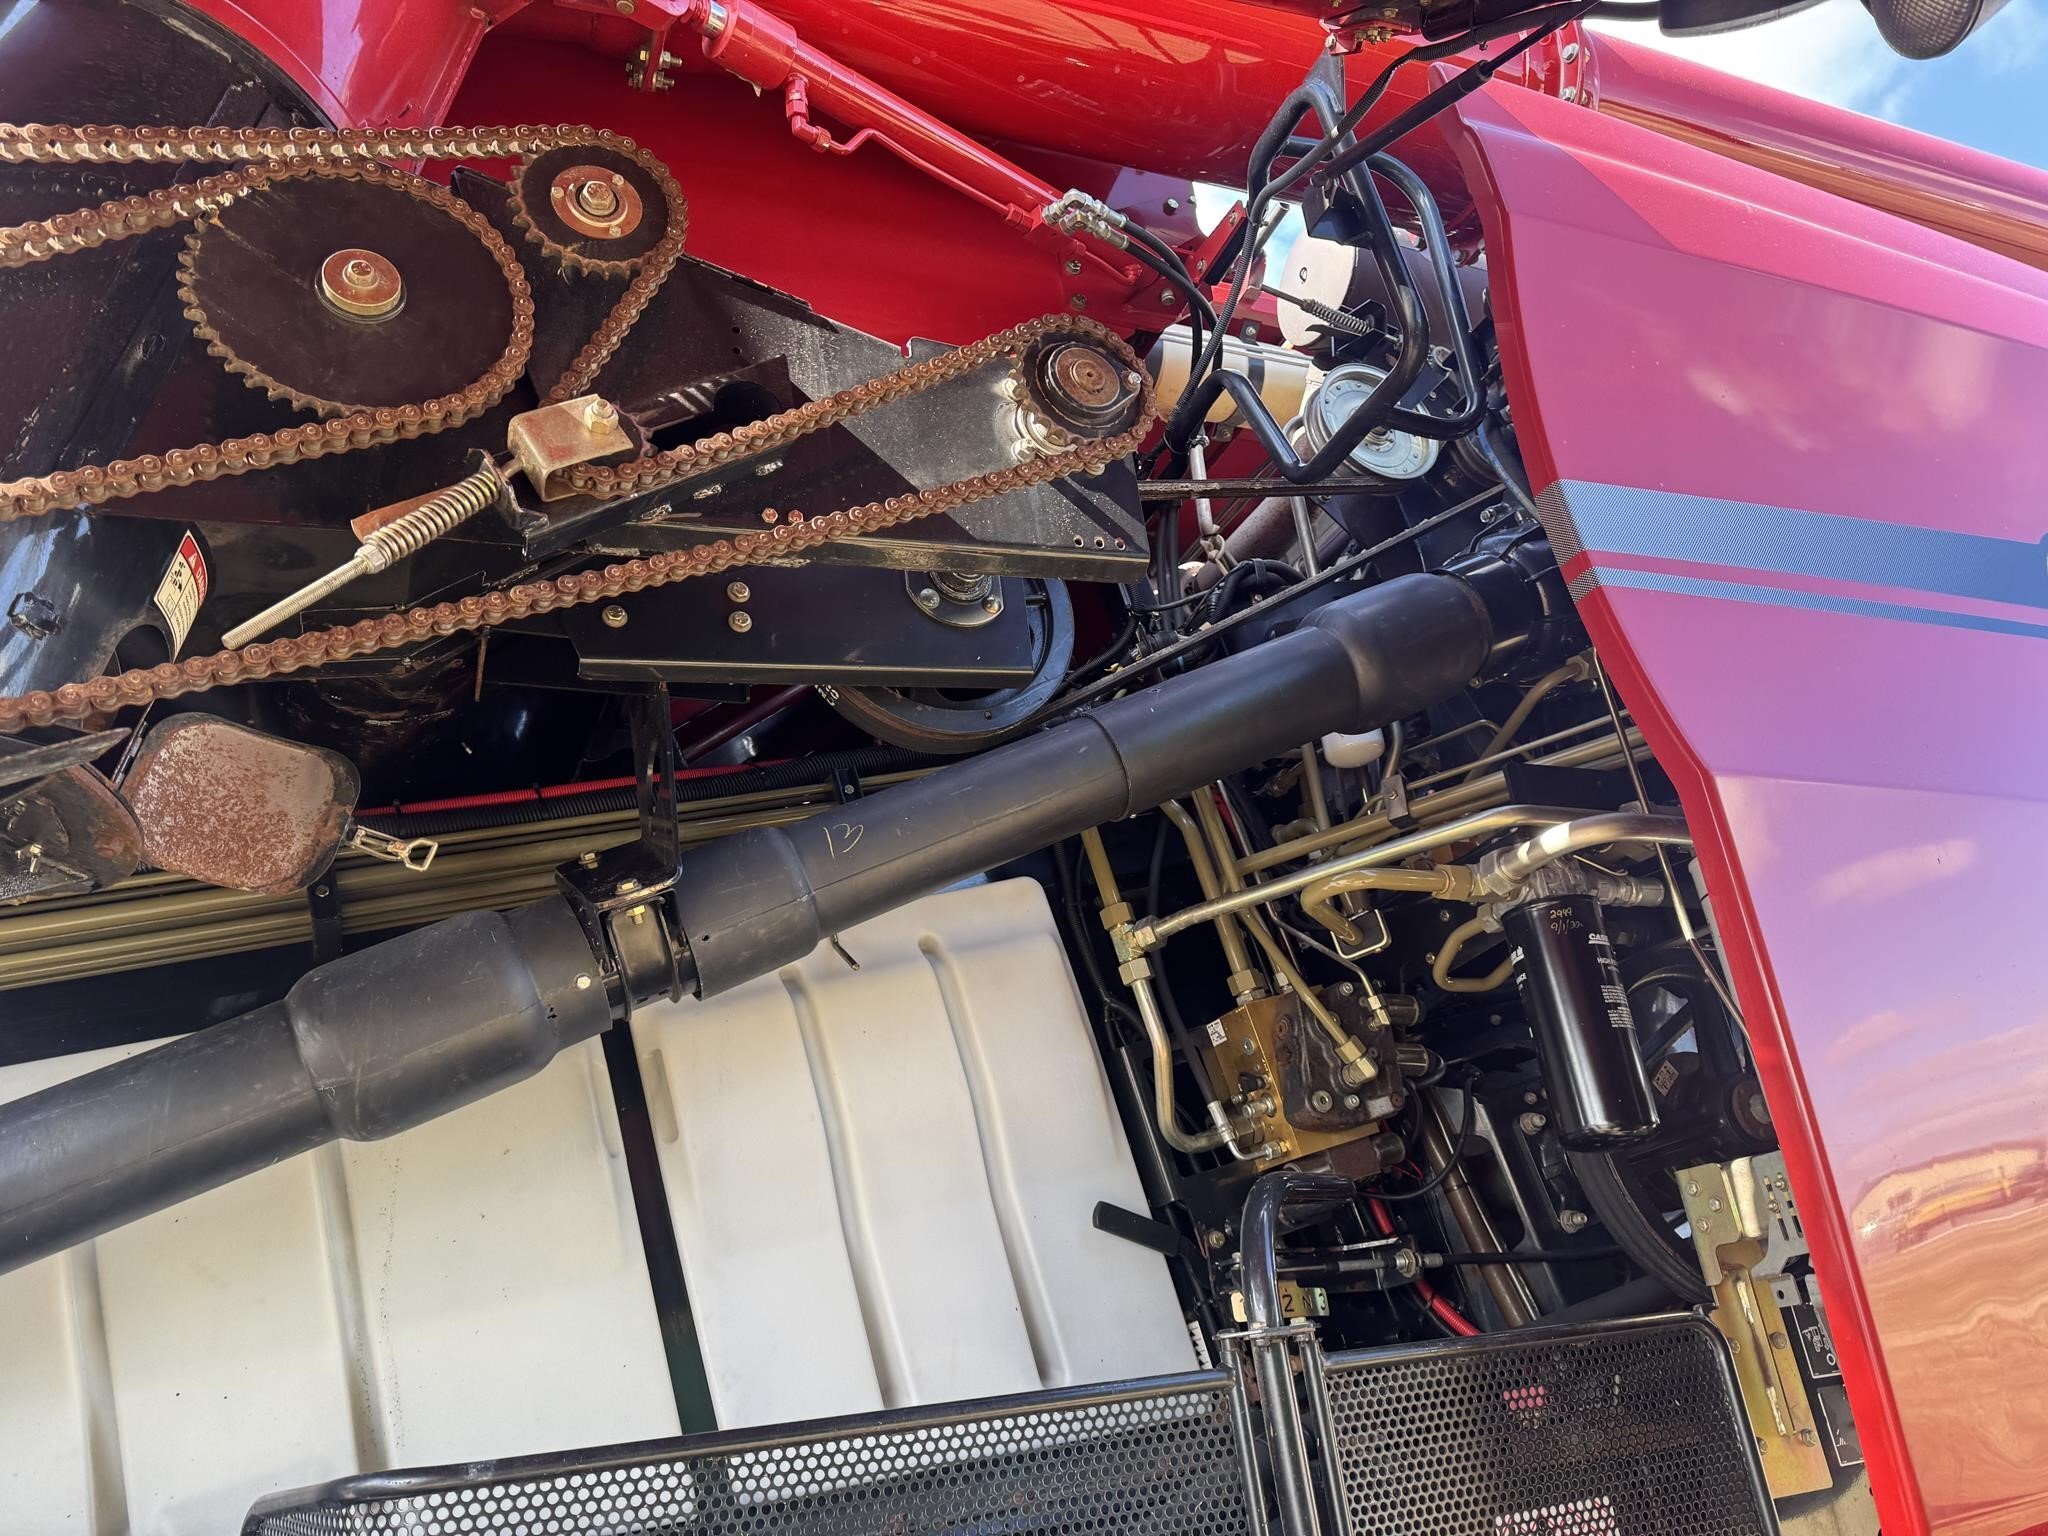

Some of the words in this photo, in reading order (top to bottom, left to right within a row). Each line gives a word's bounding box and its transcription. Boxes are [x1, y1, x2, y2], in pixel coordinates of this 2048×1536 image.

[823, 823, 864, 860] 13
[1282, 1293, 1295, 1312] 2
[1302, 1295, 1314, 1312] N
